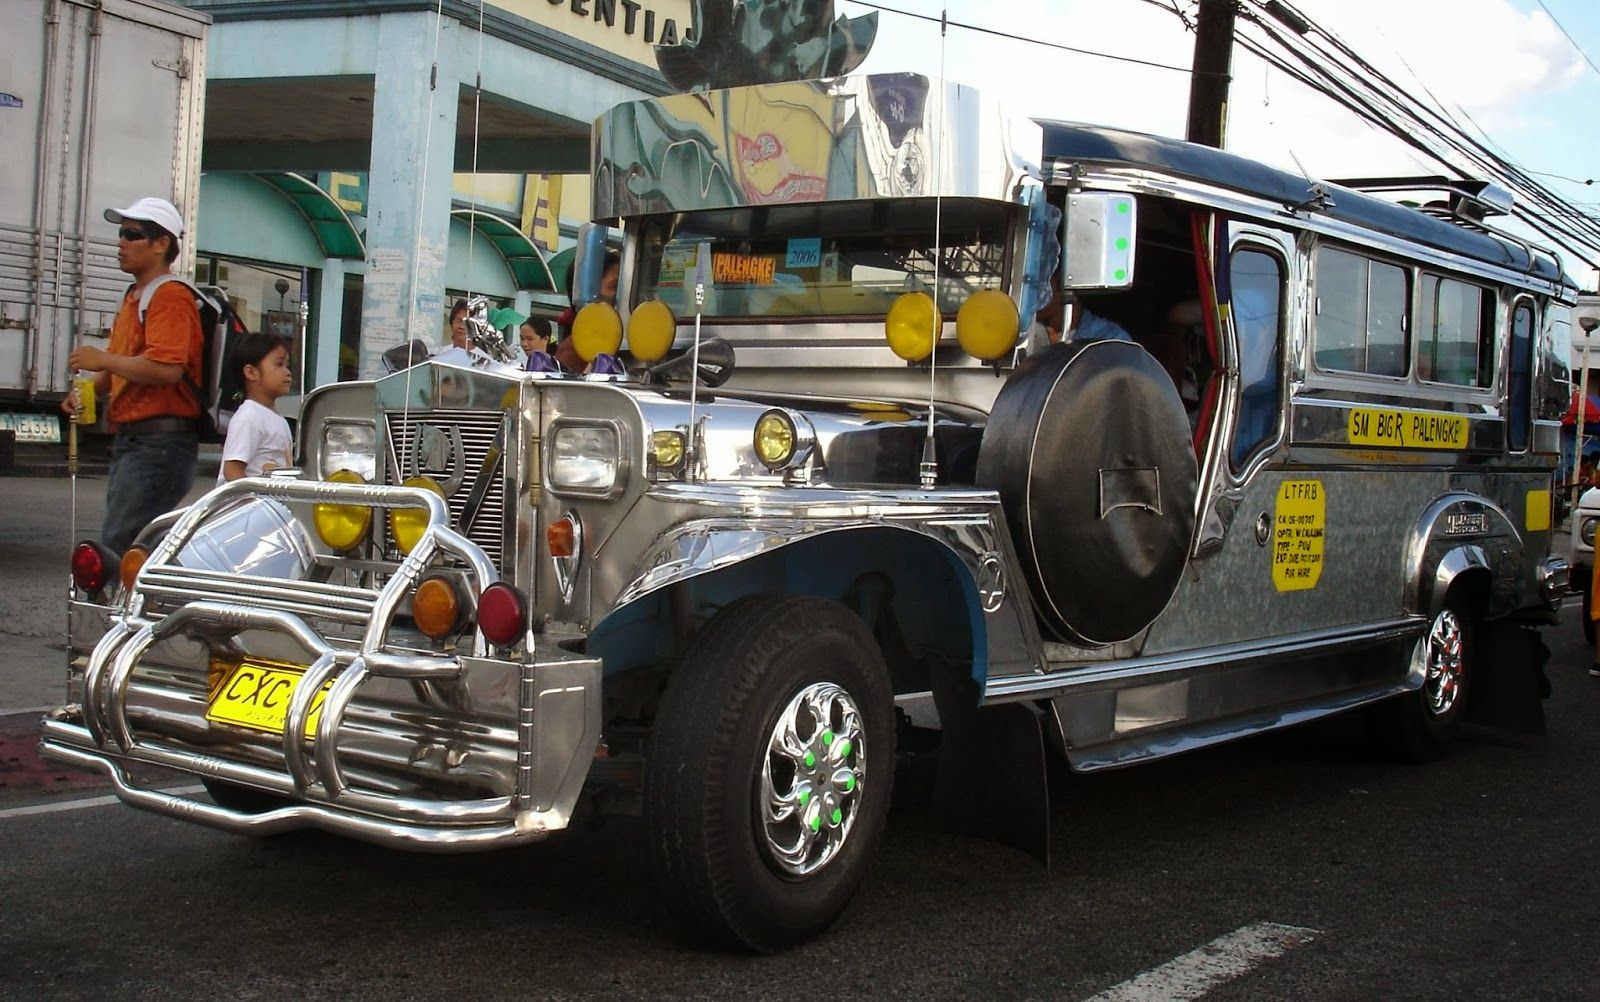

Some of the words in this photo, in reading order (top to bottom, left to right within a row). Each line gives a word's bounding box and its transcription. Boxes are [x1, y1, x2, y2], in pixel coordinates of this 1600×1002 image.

[716, 253, 773, 276] PALENGKE
[789, 250, 816, 264] 2006
[1353, 412, 1370, 437] SM
[1413, 416, 1460, 443] PALENGKE
[1285, 484, 1317, 499] LTFRB
[226, 671, 291, 708] CXC
